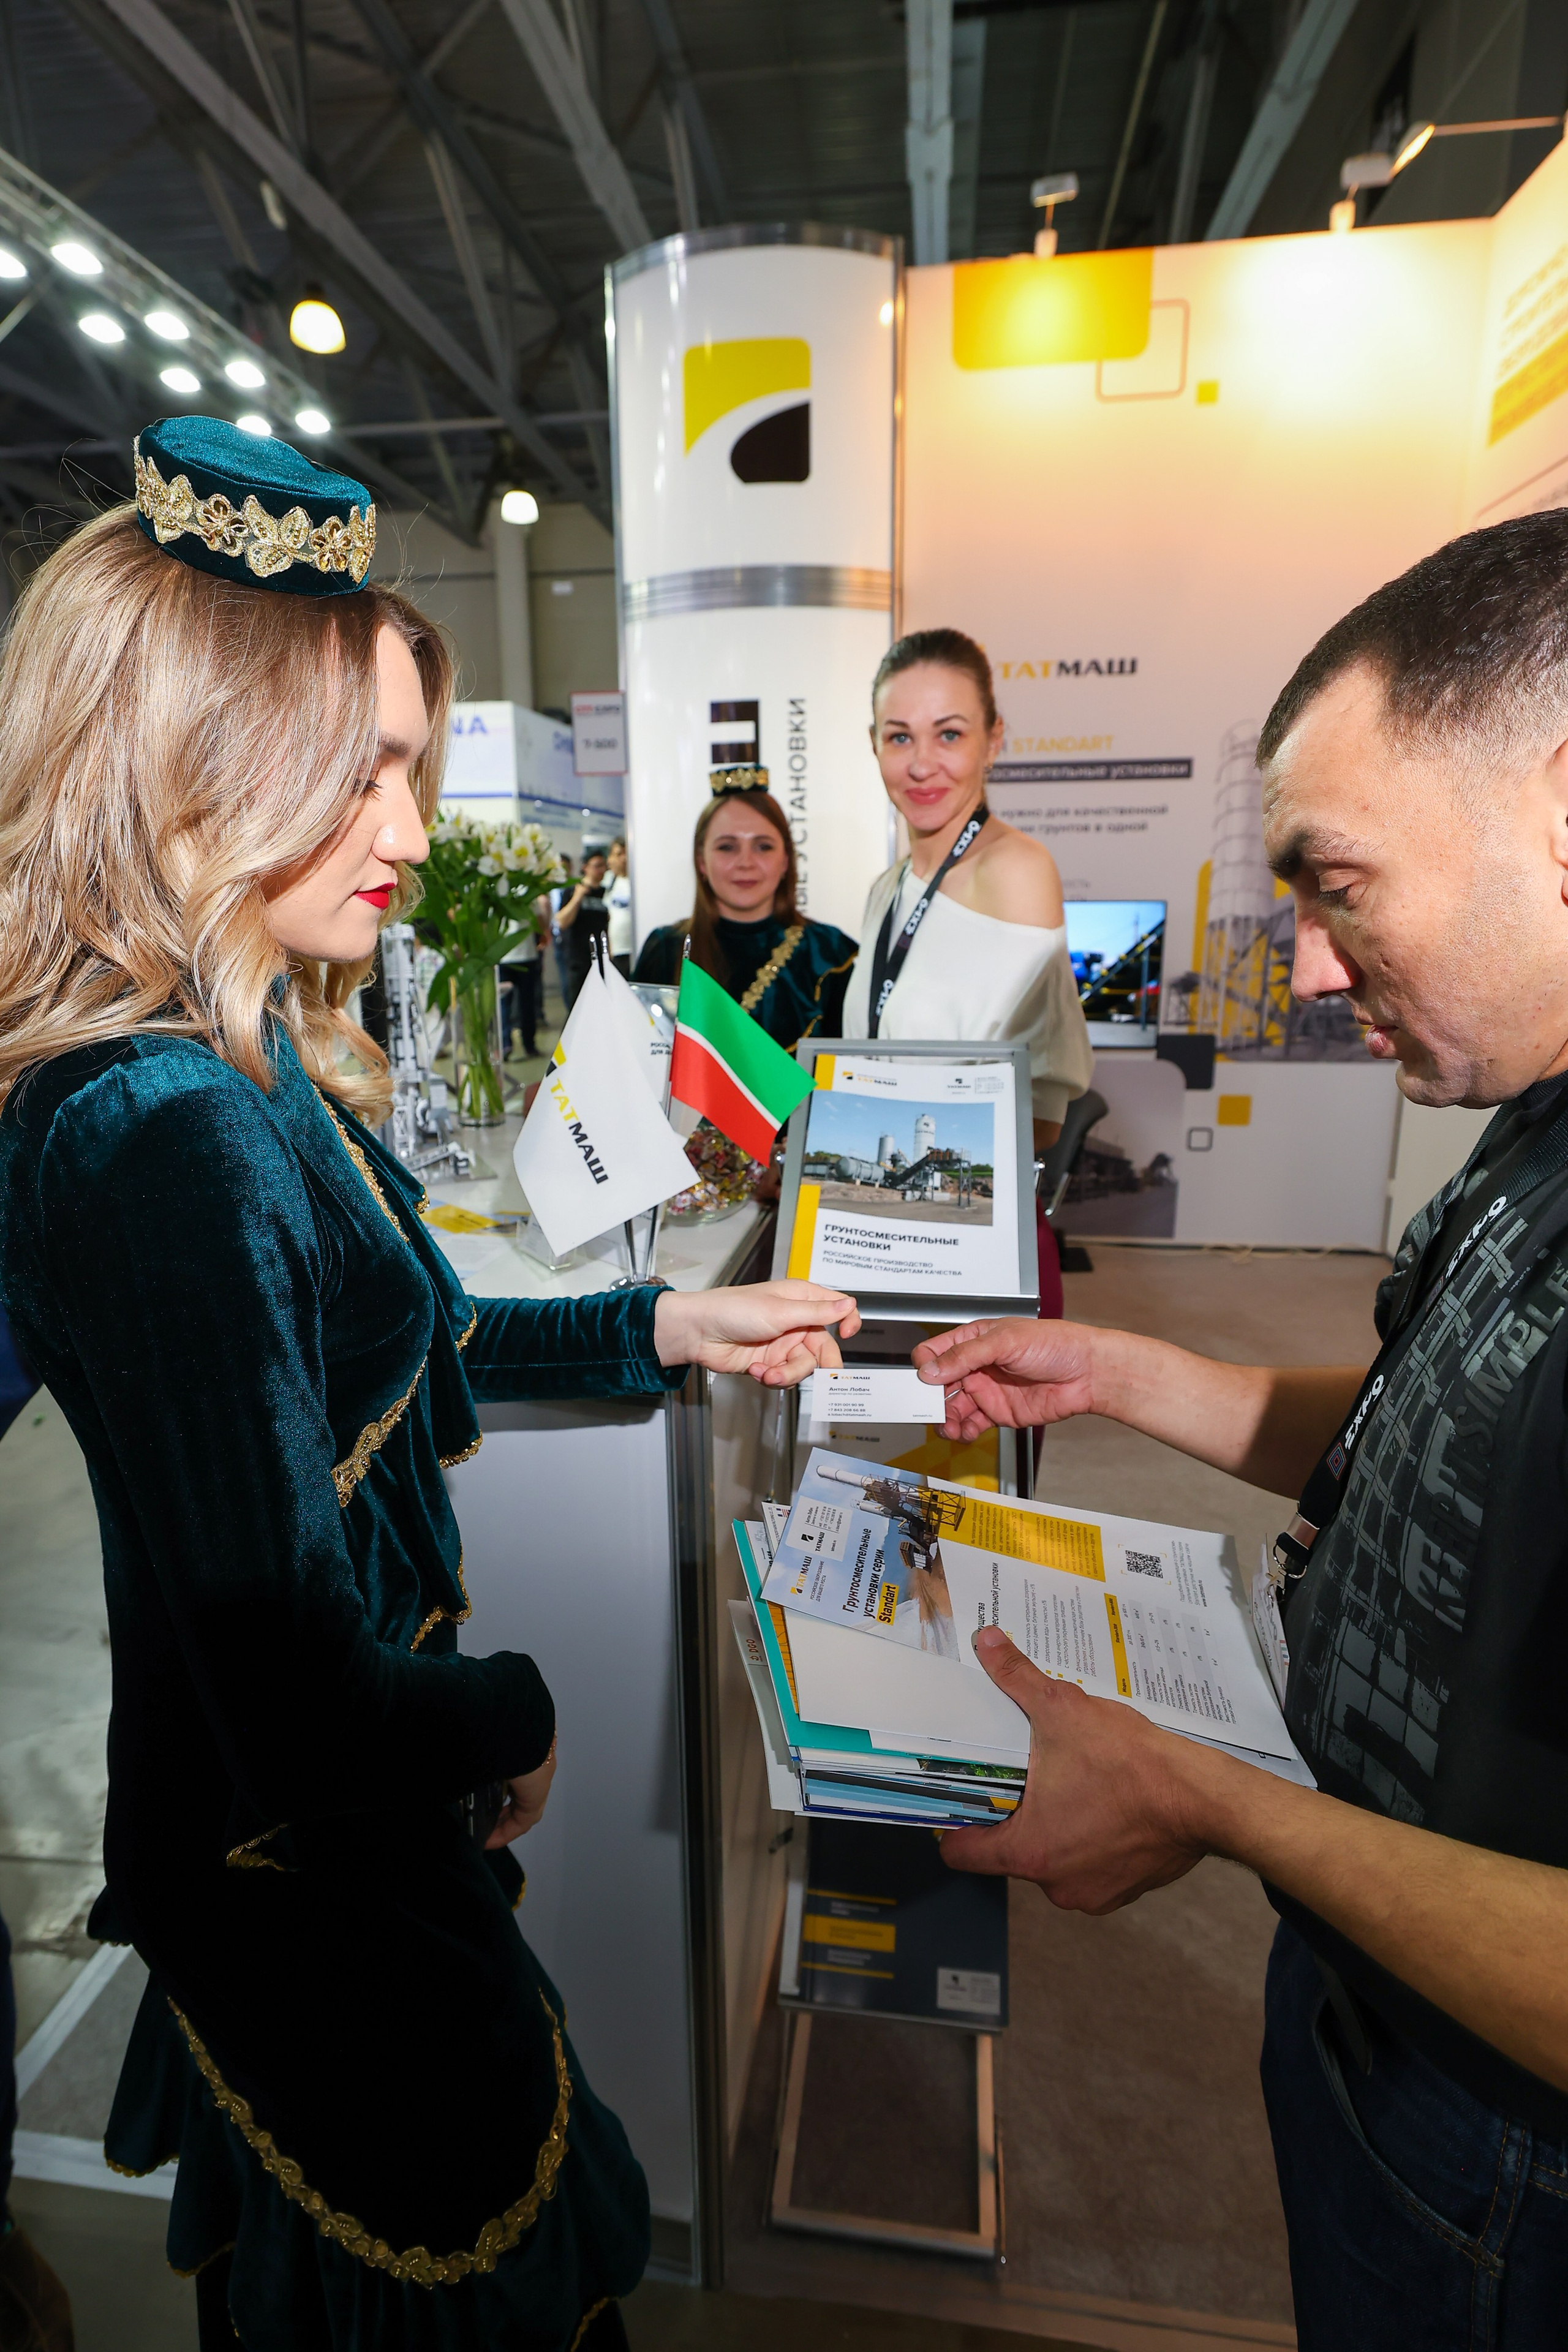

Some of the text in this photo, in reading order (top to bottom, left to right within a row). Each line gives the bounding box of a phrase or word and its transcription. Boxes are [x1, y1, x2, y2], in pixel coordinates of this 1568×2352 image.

[1000, 657, 1139, 680] ТАТМАШ
[1012, 735, 1114, 754] STANDART
[550, 1079, 609, 1185] ТАТМАШ
[823, 1235, 891, 1251] УСТАНОВКИ
[824, 1224, 960, 1246] ГРУНТОСМЕСИТЕЛЬНЫЕ
[1446, 1196, 1508, 1280] EXPO
[823, 1250, 933, 1268] РОССИЙСКОЕ ПРОИЗВОДСТВО
[835, 1259, 873, 1270] МИРОВЫМ
[874, 1265, 923, 1274] СТАНДАРТАМ
[1344, 1374, 1385, 1450] EXPO
[815, 1531, 824, 1552] ТАТМАШ
[795, 1555, 812, 1588] ТАТМАШ
[842, 1528, 872, 1613] Грунтосмесительные
[863, 1549, 885, 1619] установки серии
[991, 1562, 1001, 1590] установки
[879, 1584, 896, 1623] Standart
